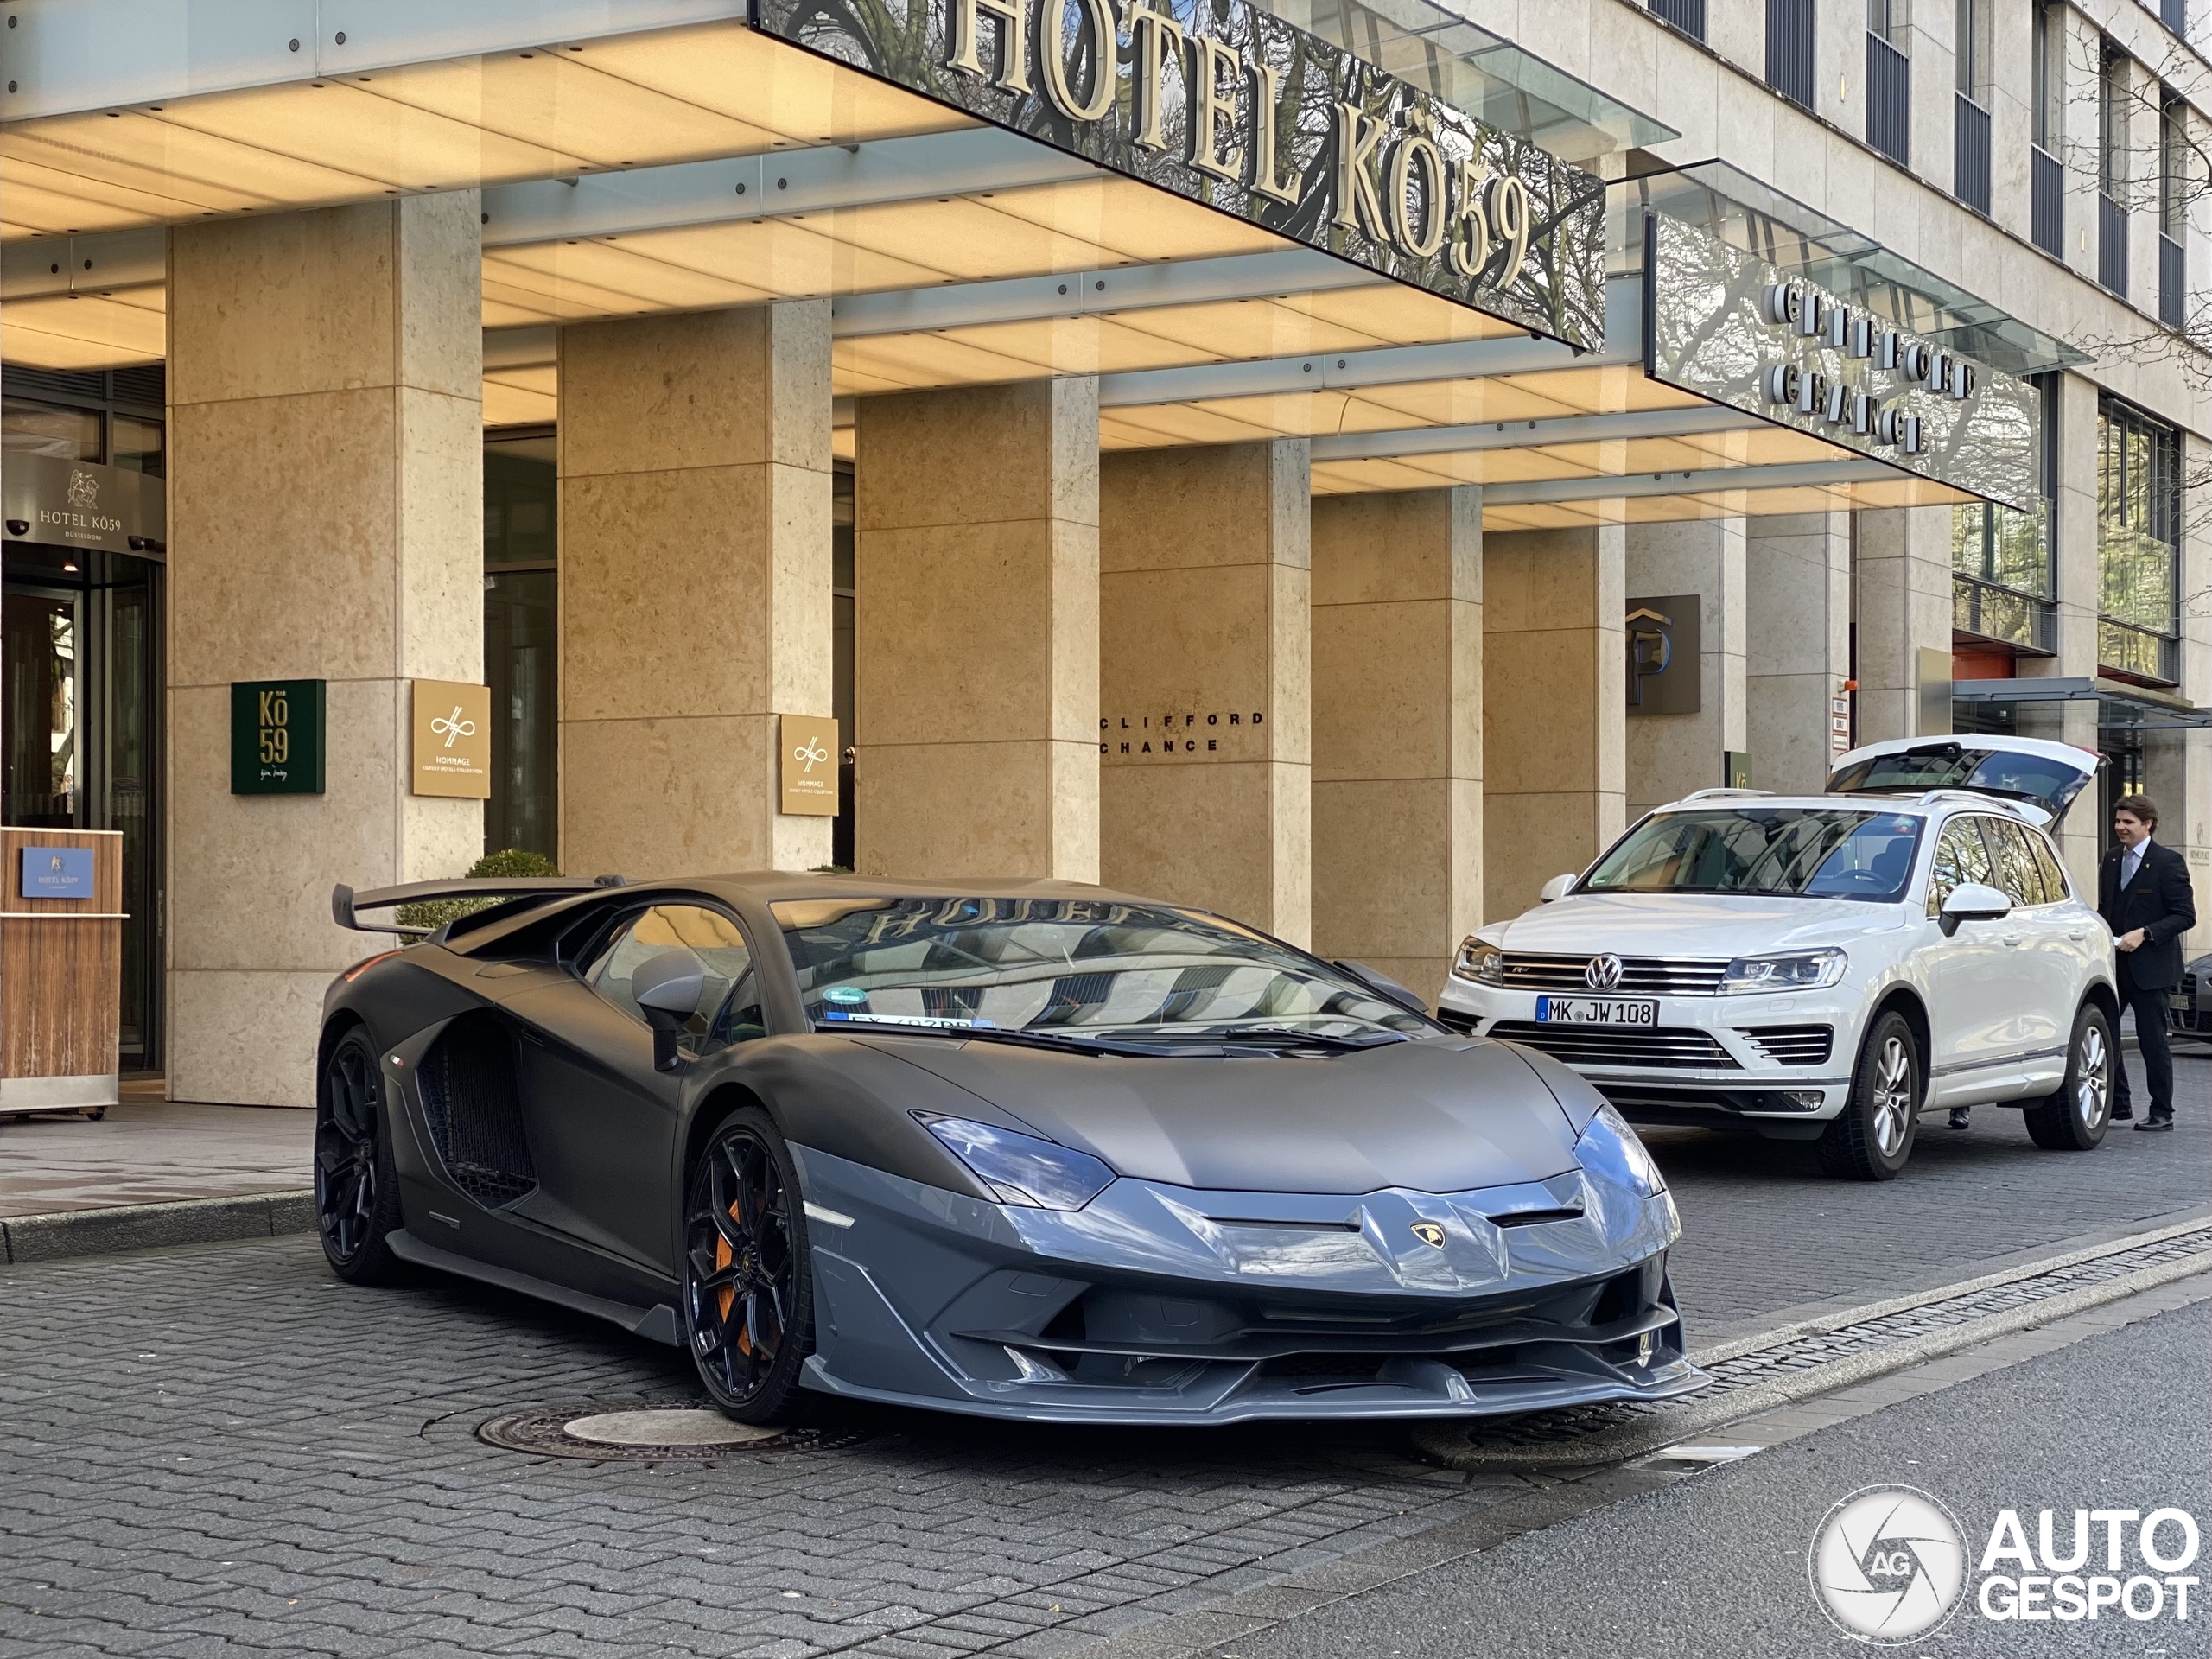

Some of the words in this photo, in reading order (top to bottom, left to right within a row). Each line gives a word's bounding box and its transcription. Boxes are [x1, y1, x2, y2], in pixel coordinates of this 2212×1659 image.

[947, 0, 1300, 205] HOTEL
[1332, 103, 1529, 290] KÖ59
[41, 510, 86, 527] HOTEL
[92, 515, 121, 531] KÖ59
[65, 531, 102, 540] DÜSSELDORF
[1100, 712, 1263, 729] CLIFFORD
[259, 728, 289, 764] 59
[1100, 739, 1217, 754] CHANCE
[435, 756, 470, 766] HOMMAGE
[798, 779, 823, 788] HOMMAGE
[1549, 1001, 1573, 1021] MK
[1586, 1002, 1611, 1022] JW
[1615, 1003, 1651, 1024] 108
